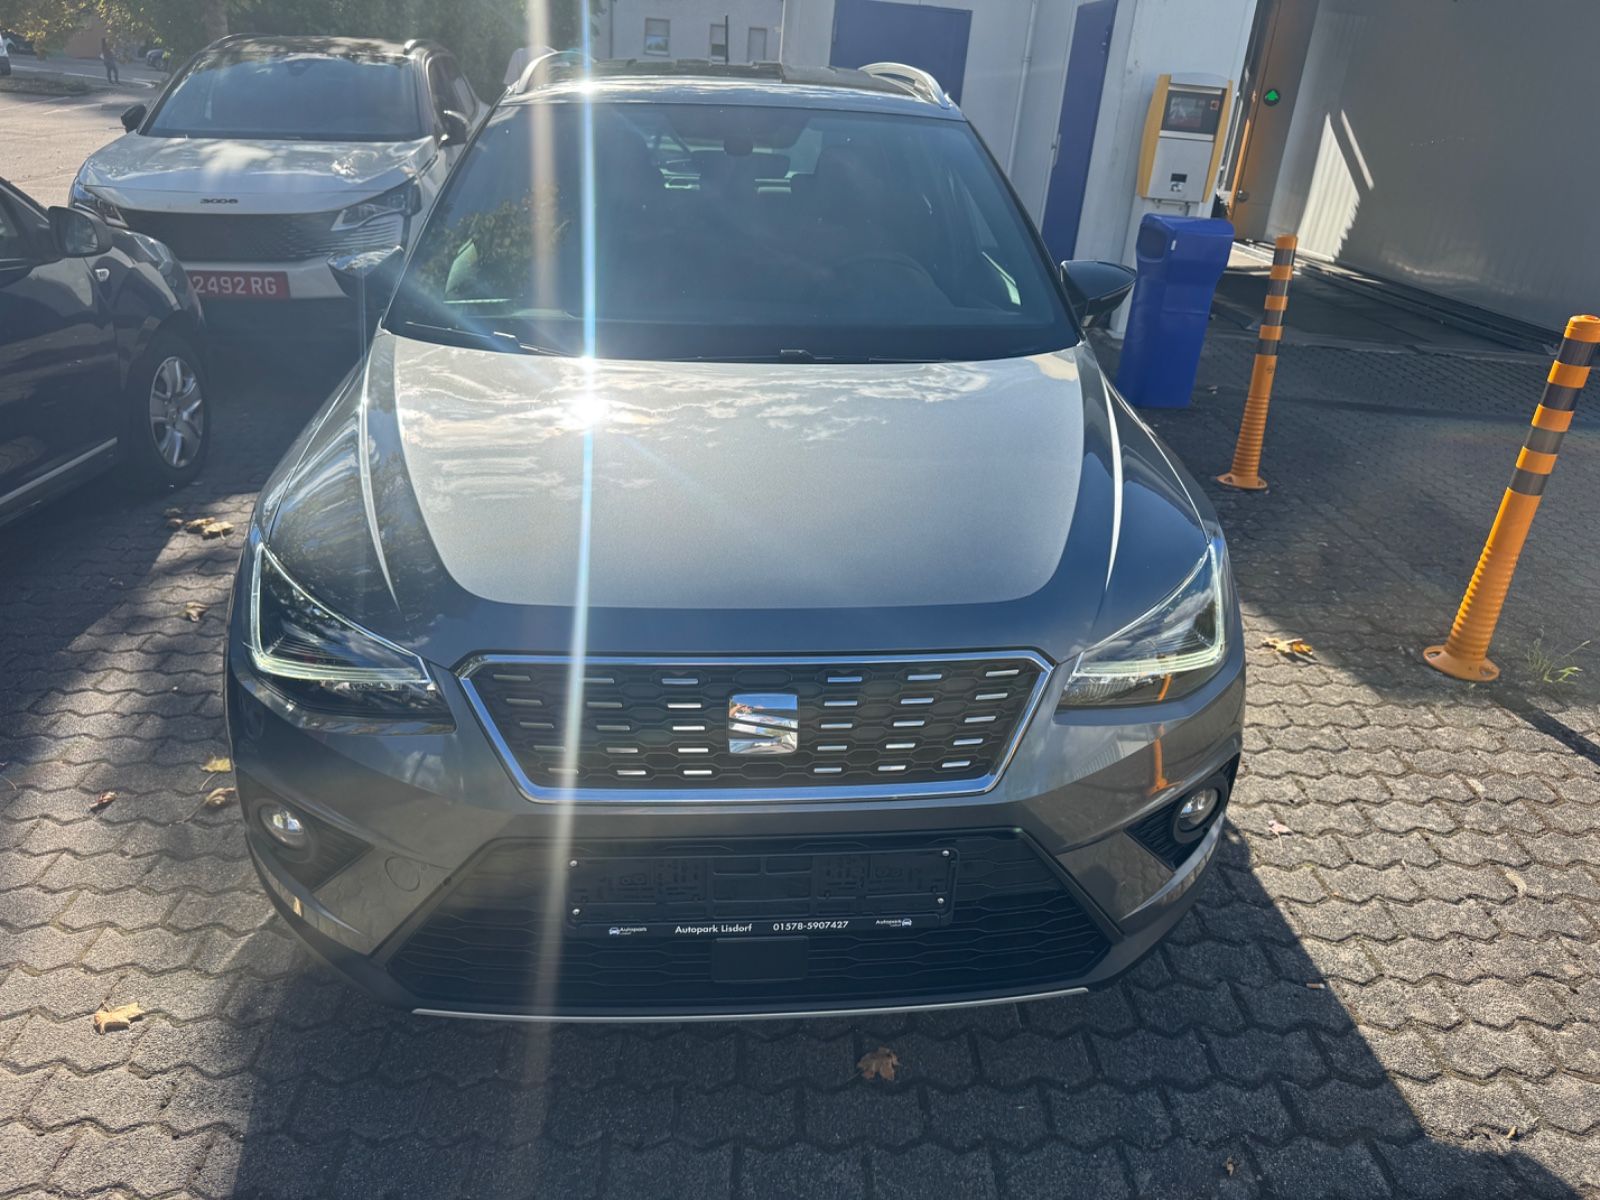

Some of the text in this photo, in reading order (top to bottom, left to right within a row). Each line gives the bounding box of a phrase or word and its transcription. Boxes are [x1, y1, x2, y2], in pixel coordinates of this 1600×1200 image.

[192, 276, 277, 294] 2492 RG
[675, 923, 752, 935] Autopark Lisdorf
[773, 921, 848, 931] 01578-5907427
